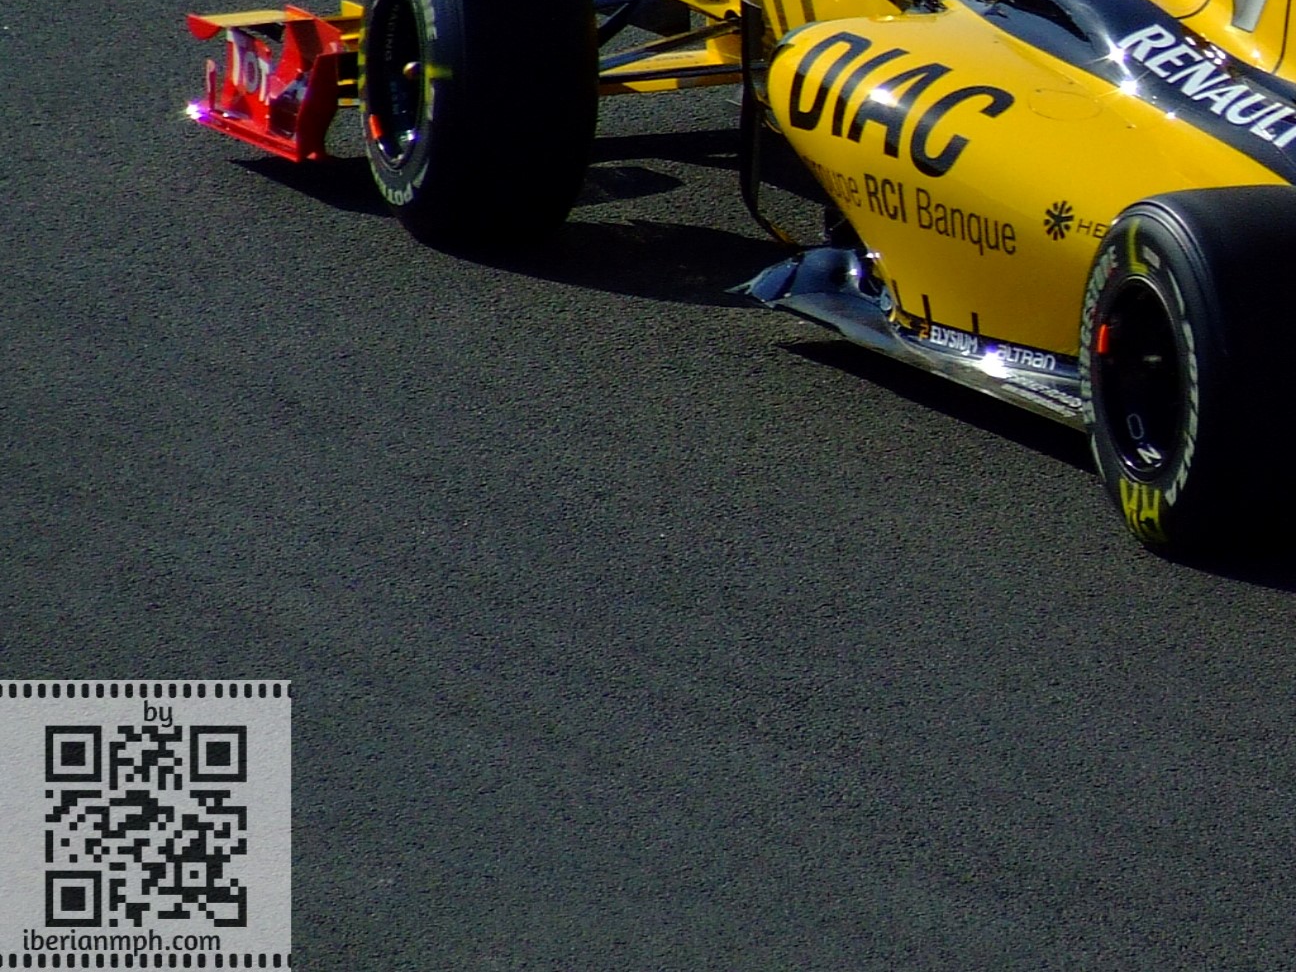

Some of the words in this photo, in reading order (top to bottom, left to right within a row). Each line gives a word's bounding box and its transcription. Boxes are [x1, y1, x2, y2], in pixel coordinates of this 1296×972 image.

[789, 31, 1015, 178] DIAC
[863, 173, 908, 224] RCI
[916, 188, 1017, 256] Banque
